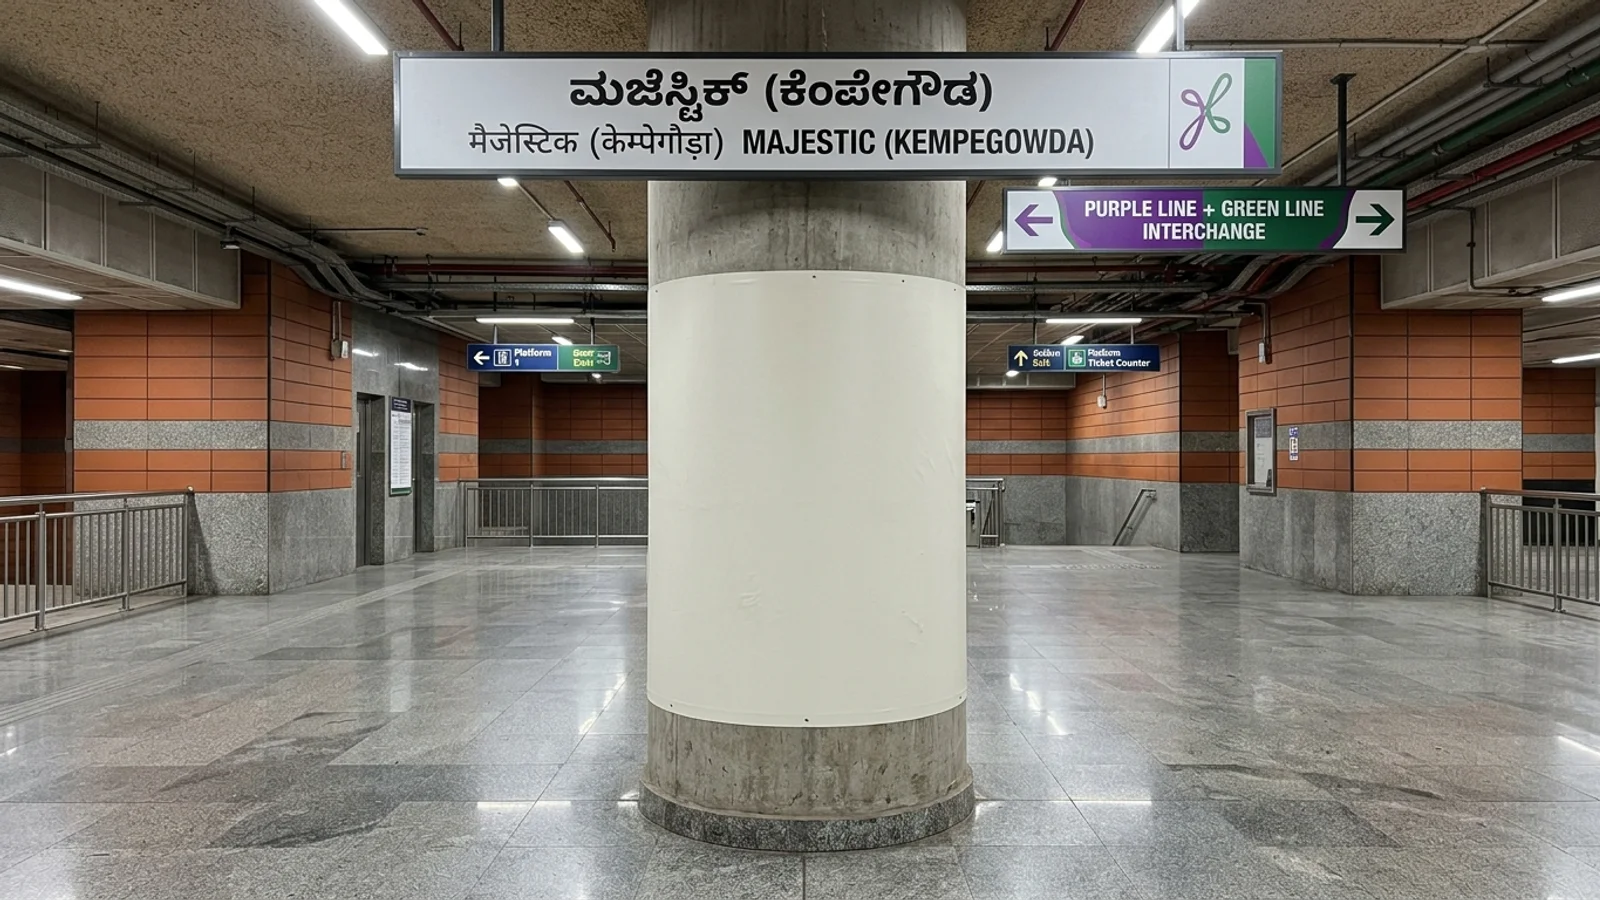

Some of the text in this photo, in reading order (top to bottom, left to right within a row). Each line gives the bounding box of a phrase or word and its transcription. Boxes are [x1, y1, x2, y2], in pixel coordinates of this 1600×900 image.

[569, 68, 993, 122] ಮಜೆಸ್ಟಿಕ್ (ಕೆಂಪೇಗೌಡ)
[468, 123, 724, 161] मैजेस्टिक (केम्पेगौड़ा)
[743, 128, 1094, 160] MAJESTIC (KEMPEGOWDA)
[1085, 200, 1324, 217] PURPLE LINE + GREEN LINE
[1143, 223, 1266, 240] INTERCHANGE
[514, 348, 552, 357] Platform
[1115, 358, 1151, 367] Counter
